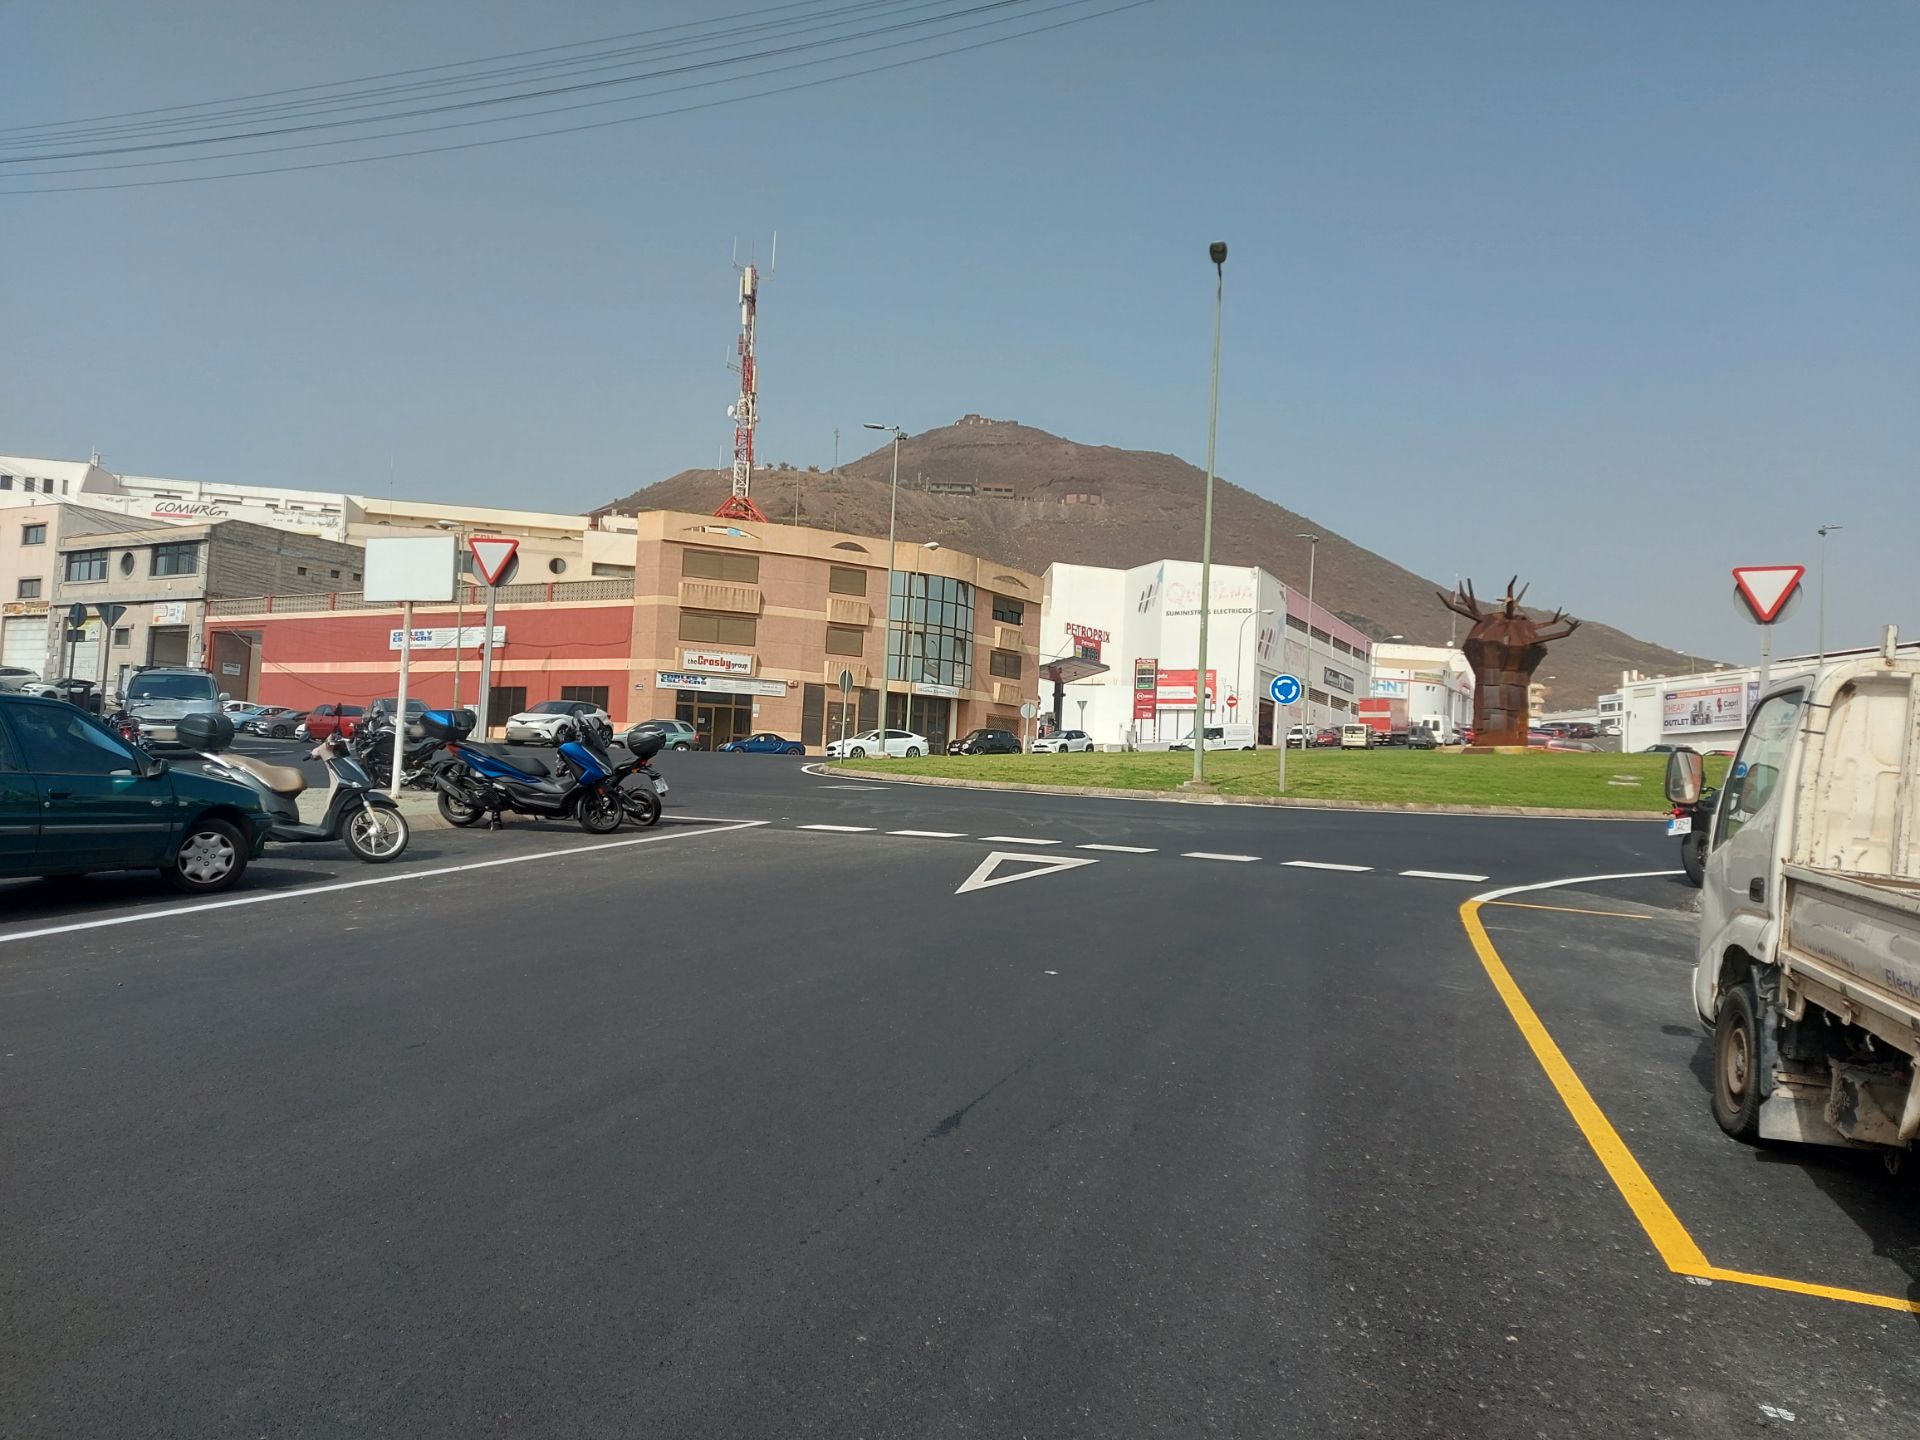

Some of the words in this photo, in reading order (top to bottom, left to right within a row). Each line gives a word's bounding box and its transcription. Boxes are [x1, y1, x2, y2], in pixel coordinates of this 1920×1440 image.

[1165, 609, 1212, 617] SUMINISTRS
[1213, 607, 1253, 615] ELECTRICOS
[1064, 622, 1111, 643] PETROPRIX
[697, 655, 732, 670] Crosby
[1664, 718, 1690, 727] OUTLET
